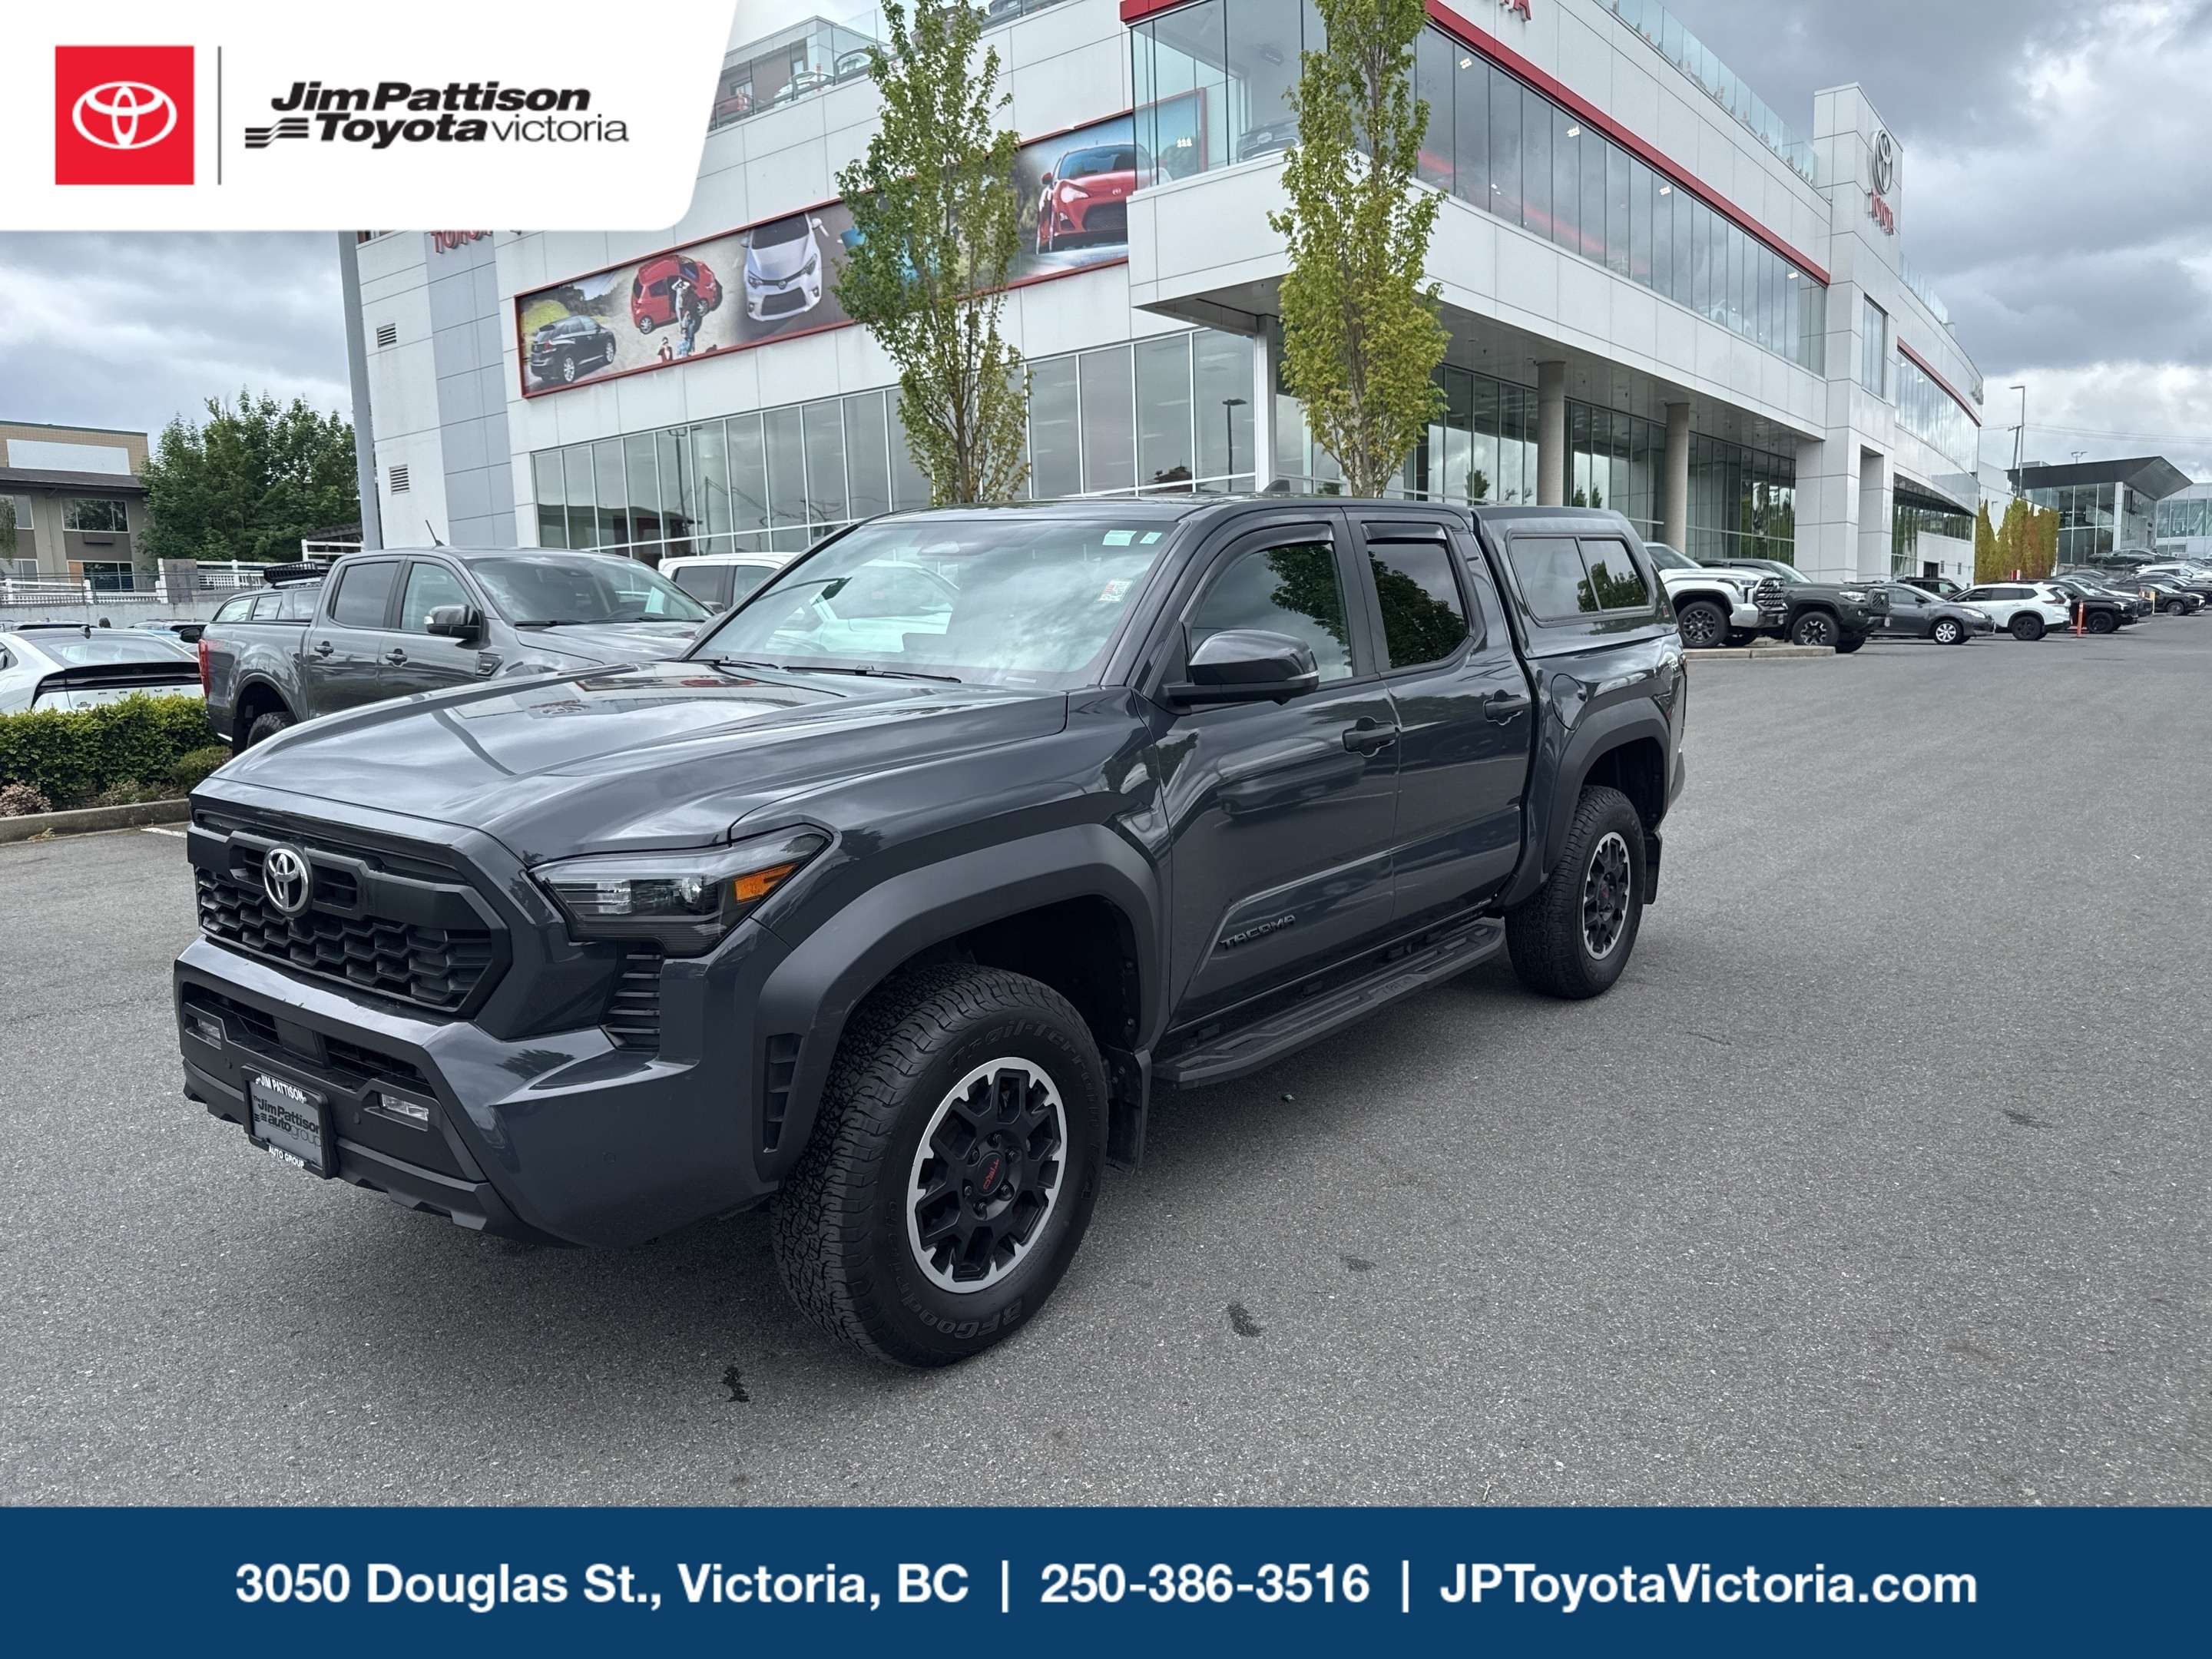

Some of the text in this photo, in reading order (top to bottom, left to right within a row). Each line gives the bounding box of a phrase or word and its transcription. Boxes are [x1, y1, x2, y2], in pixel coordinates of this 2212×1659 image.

[1219, 914, 1296, 949] TACOMA
[261, 1075, 304, 1102] JIM PATTISON
[269, 1145, 305, 1168] AUTO GROUP
